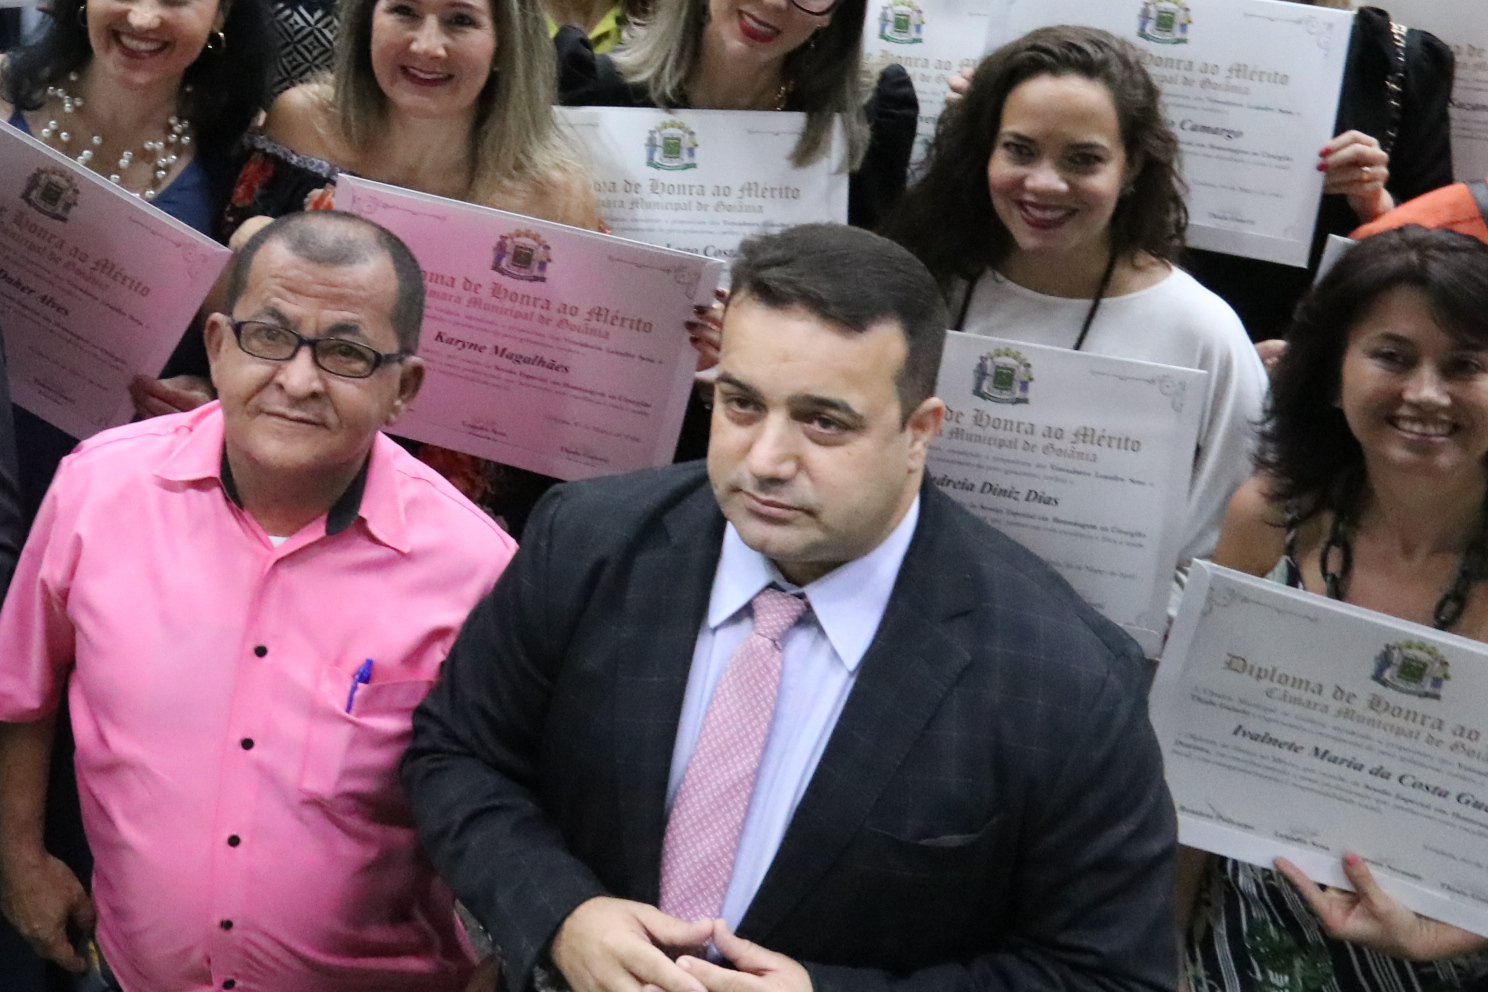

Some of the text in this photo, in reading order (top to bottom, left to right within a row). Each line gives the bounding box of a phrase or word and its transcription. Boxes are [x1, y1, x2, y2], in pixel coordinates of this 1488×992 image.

[1199, 63, 1219, 76] ao
[1227, 62, 1289, 86] Mérito
[1179, 119, 1244, 141] Camargo
[623, 178, 800, 201] de Honra ao Mérito
[12, 210, 66, 250] Honra
[68, 246, 89, 263] ao
[90, 258, 151, 297] Mérito
[462, 277, 482, 294] de
[490, 281, 551, 310] Honra
[560, 303, 579, 317] ao
[585, 306, 653, 334] Mérito
[434, 331, 570, 374] Karyne Magalhães
[972, 408, 1035, 436] Honra
[1041, 425, 1063, 440] ao
[1072, 424, 1142, 454] Mérito
[980, 481, 1021, 502] Diniz
[1024, 488, 1060, 507] Dias
[1223, 652, 1481, 742] Diploma de Honra ao
[1310, 746, 1364, 772] Maria
[1368, 765, 1392, 781] da
[1398, 773, 1450, 798] Costa
